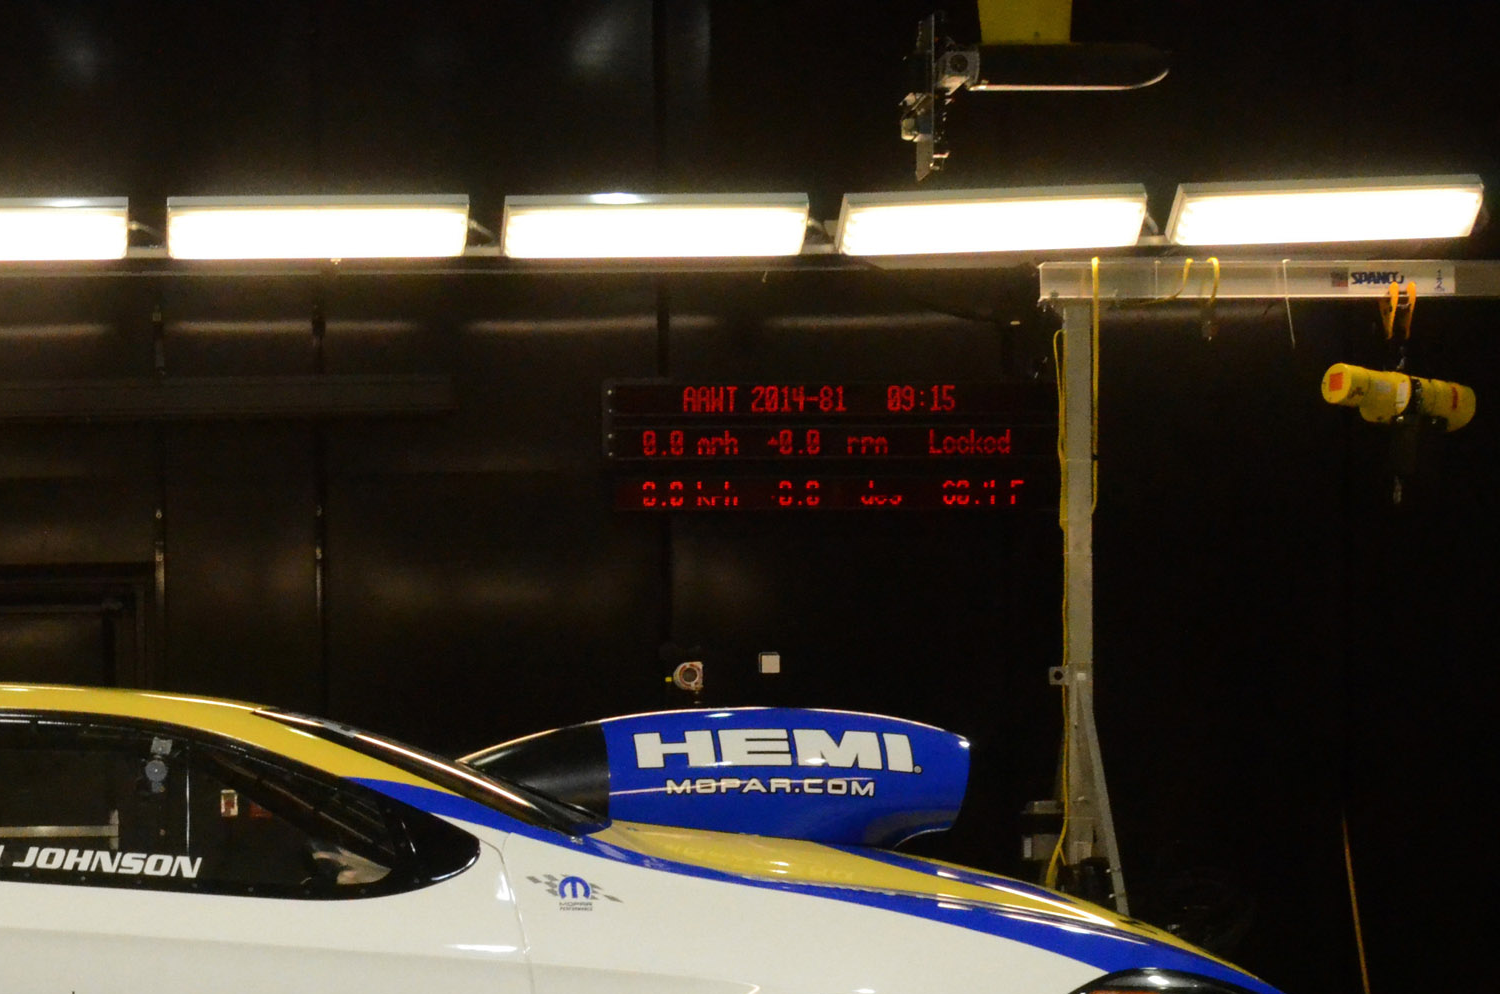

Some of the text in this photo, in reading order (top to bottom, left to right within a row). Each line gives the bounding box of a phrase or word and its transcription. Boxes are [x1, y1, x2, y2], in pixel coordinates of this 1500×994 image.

[751, 385, 847, 412] 2014-81
[887, 385, 955, 411] 09:15
[633, 728, 914, 773] HEMI
[665, 778, 875, 797] MOPAR.COM
[13, 846, 203, 879] JOHNSON
